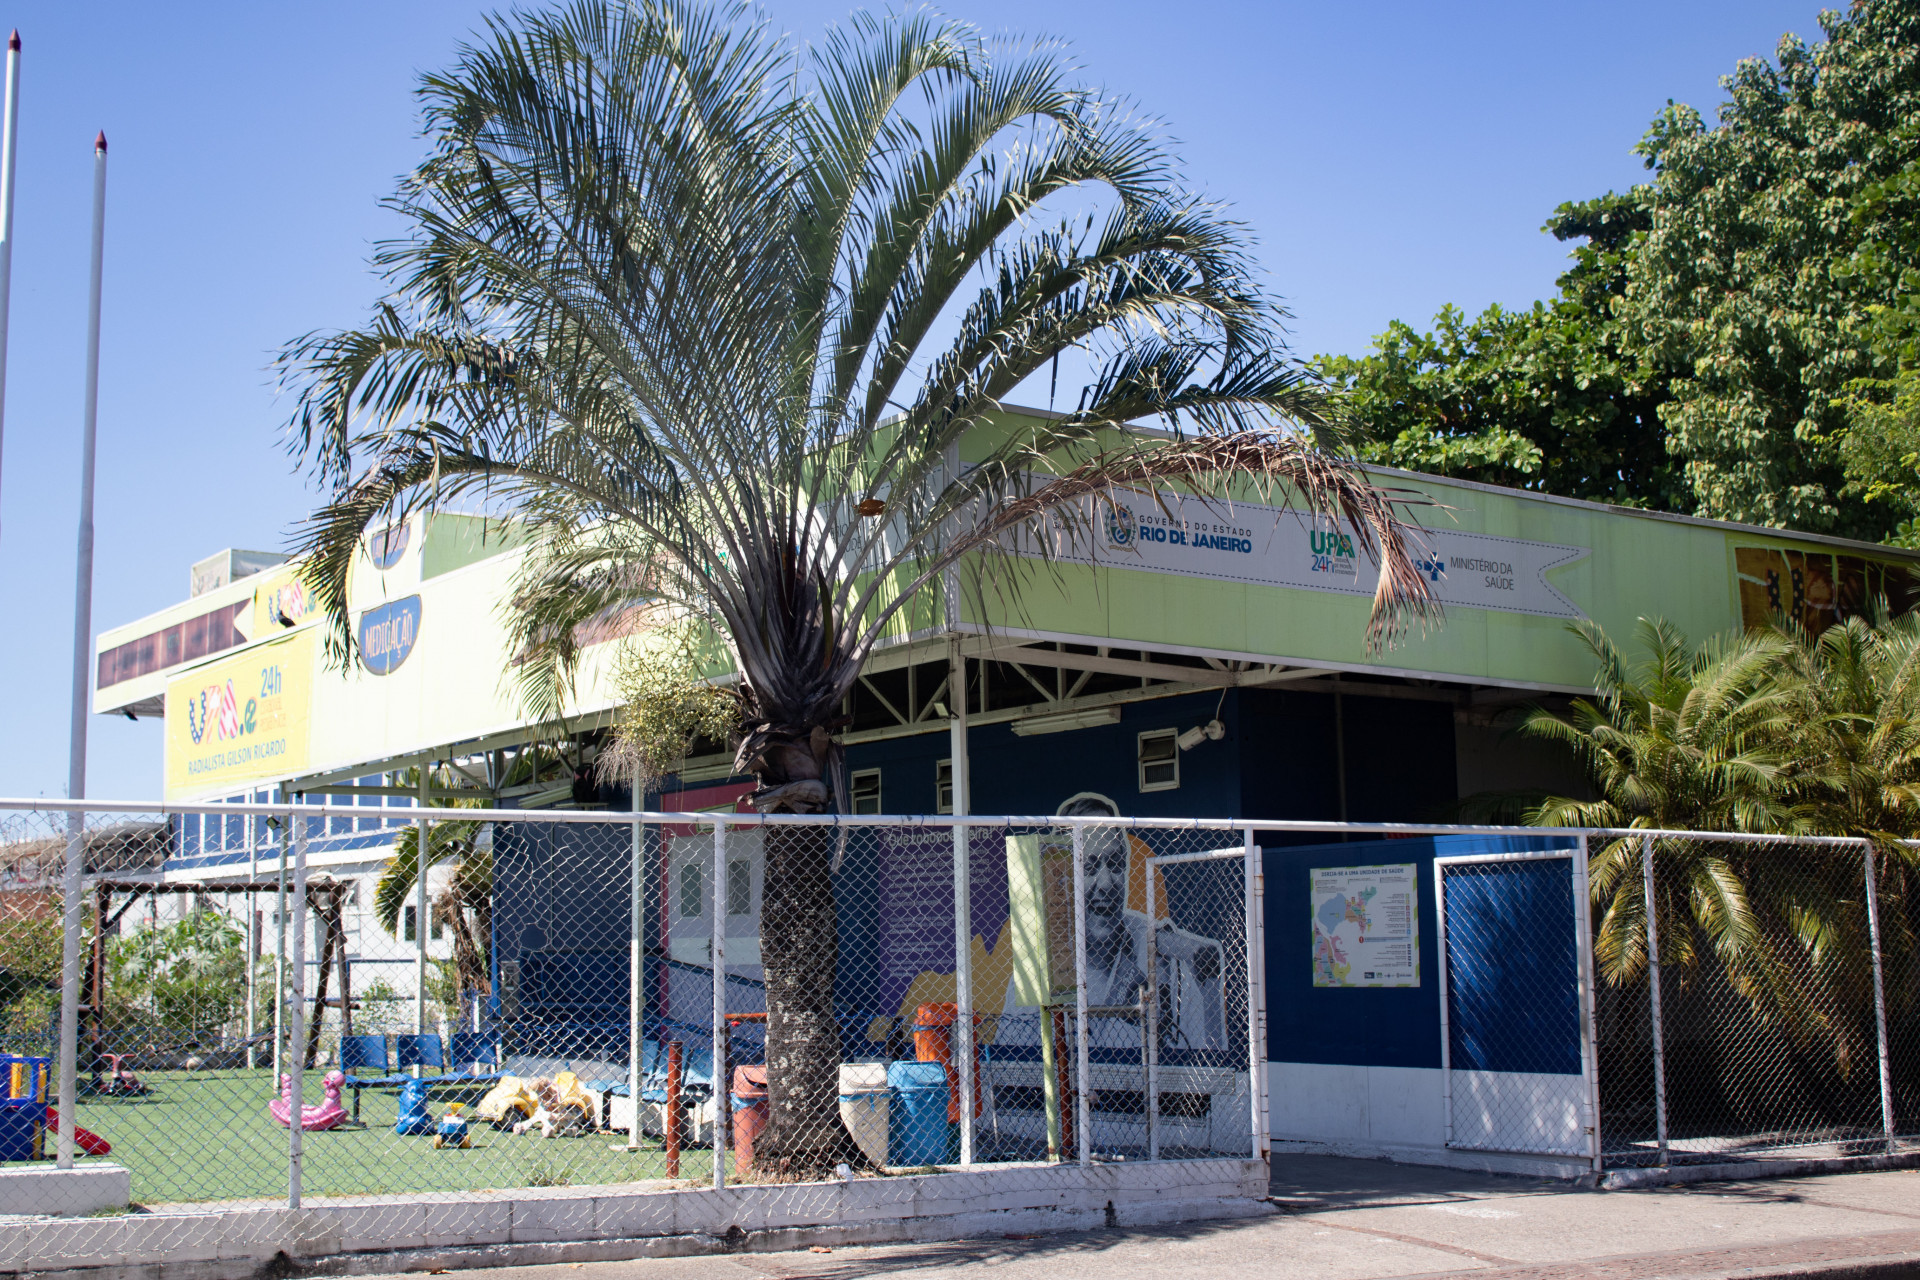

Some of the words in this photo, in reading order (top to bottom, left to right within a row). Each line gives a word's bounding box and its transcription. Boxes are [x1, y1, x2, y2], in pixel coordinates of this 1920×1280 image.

[1139, 515, 1189, 529] GOVERNO
[1195, 522, 1208, 531] DO
[1213, 525, 1252, 537] ESTADO
[1139, 526, 1167, 543] RIO
[1169, 529, 1189, 546] DE
[1192, 535, 1252, 553] JANEIRO
[1310, 530, 1356, 558] UPA
[1311, 554, 1335, 573] 24h
[1450, 556, 1499, 574] MINISTÉRIO
[1499, 562, 1513, 575] DA
[1485, 575, 1515, 591] SAÚDE
[364, 608, 414, 658] MEDICAÇÃO
[260, 664, 282, 698] 24h
[188, 753, 226, 775] RADIALISTA
[227, 746, 252, 767] GILSON
[253, 738, 286, 760] RICARDO
[1388, 866, 1404, 874] SAÚDE
